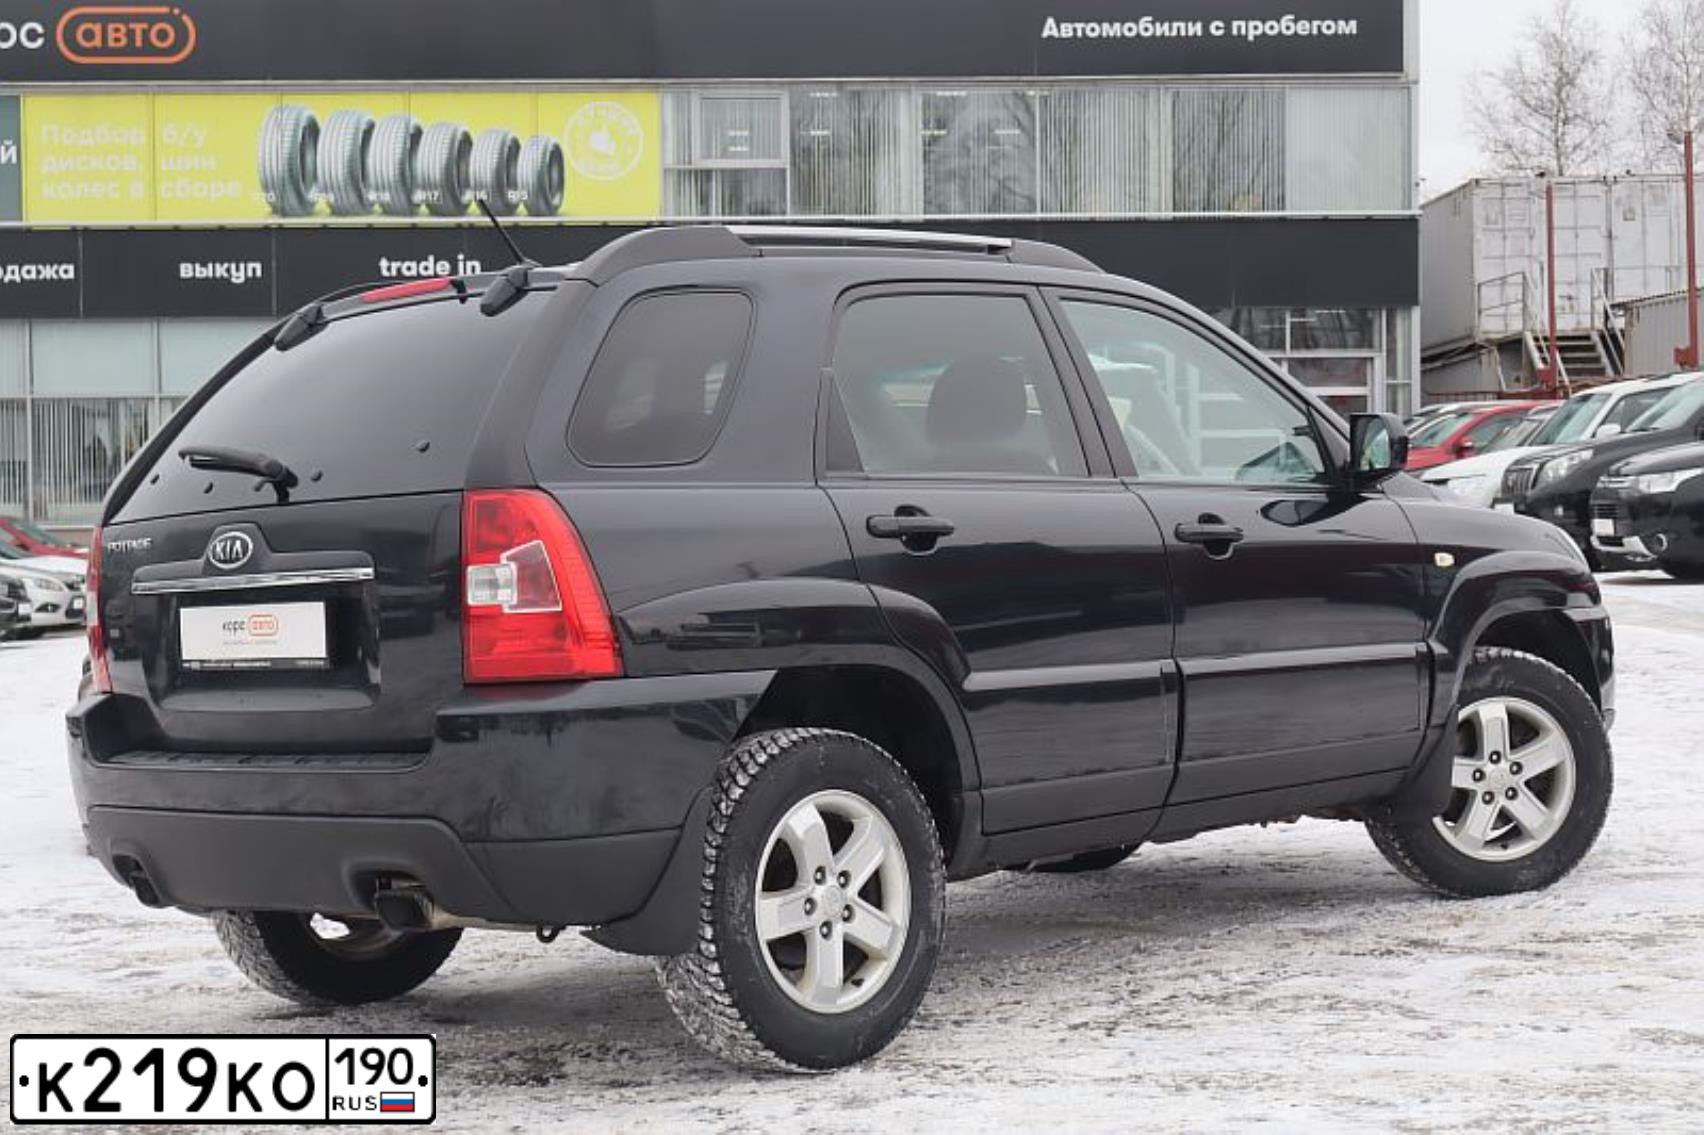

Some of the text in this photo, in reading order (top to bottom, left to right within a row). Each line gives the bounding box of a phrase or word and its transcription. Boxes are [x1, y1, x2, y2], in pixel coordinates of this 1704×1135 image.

[75, 22, 176, 48] авто
[1041, 14, 1358, 41] Автомобили с пробегом
[179, 262, 263, 284] выкуп
[379, 253, 481, 277] trade in
[214, 539, 244, 561] KIA
